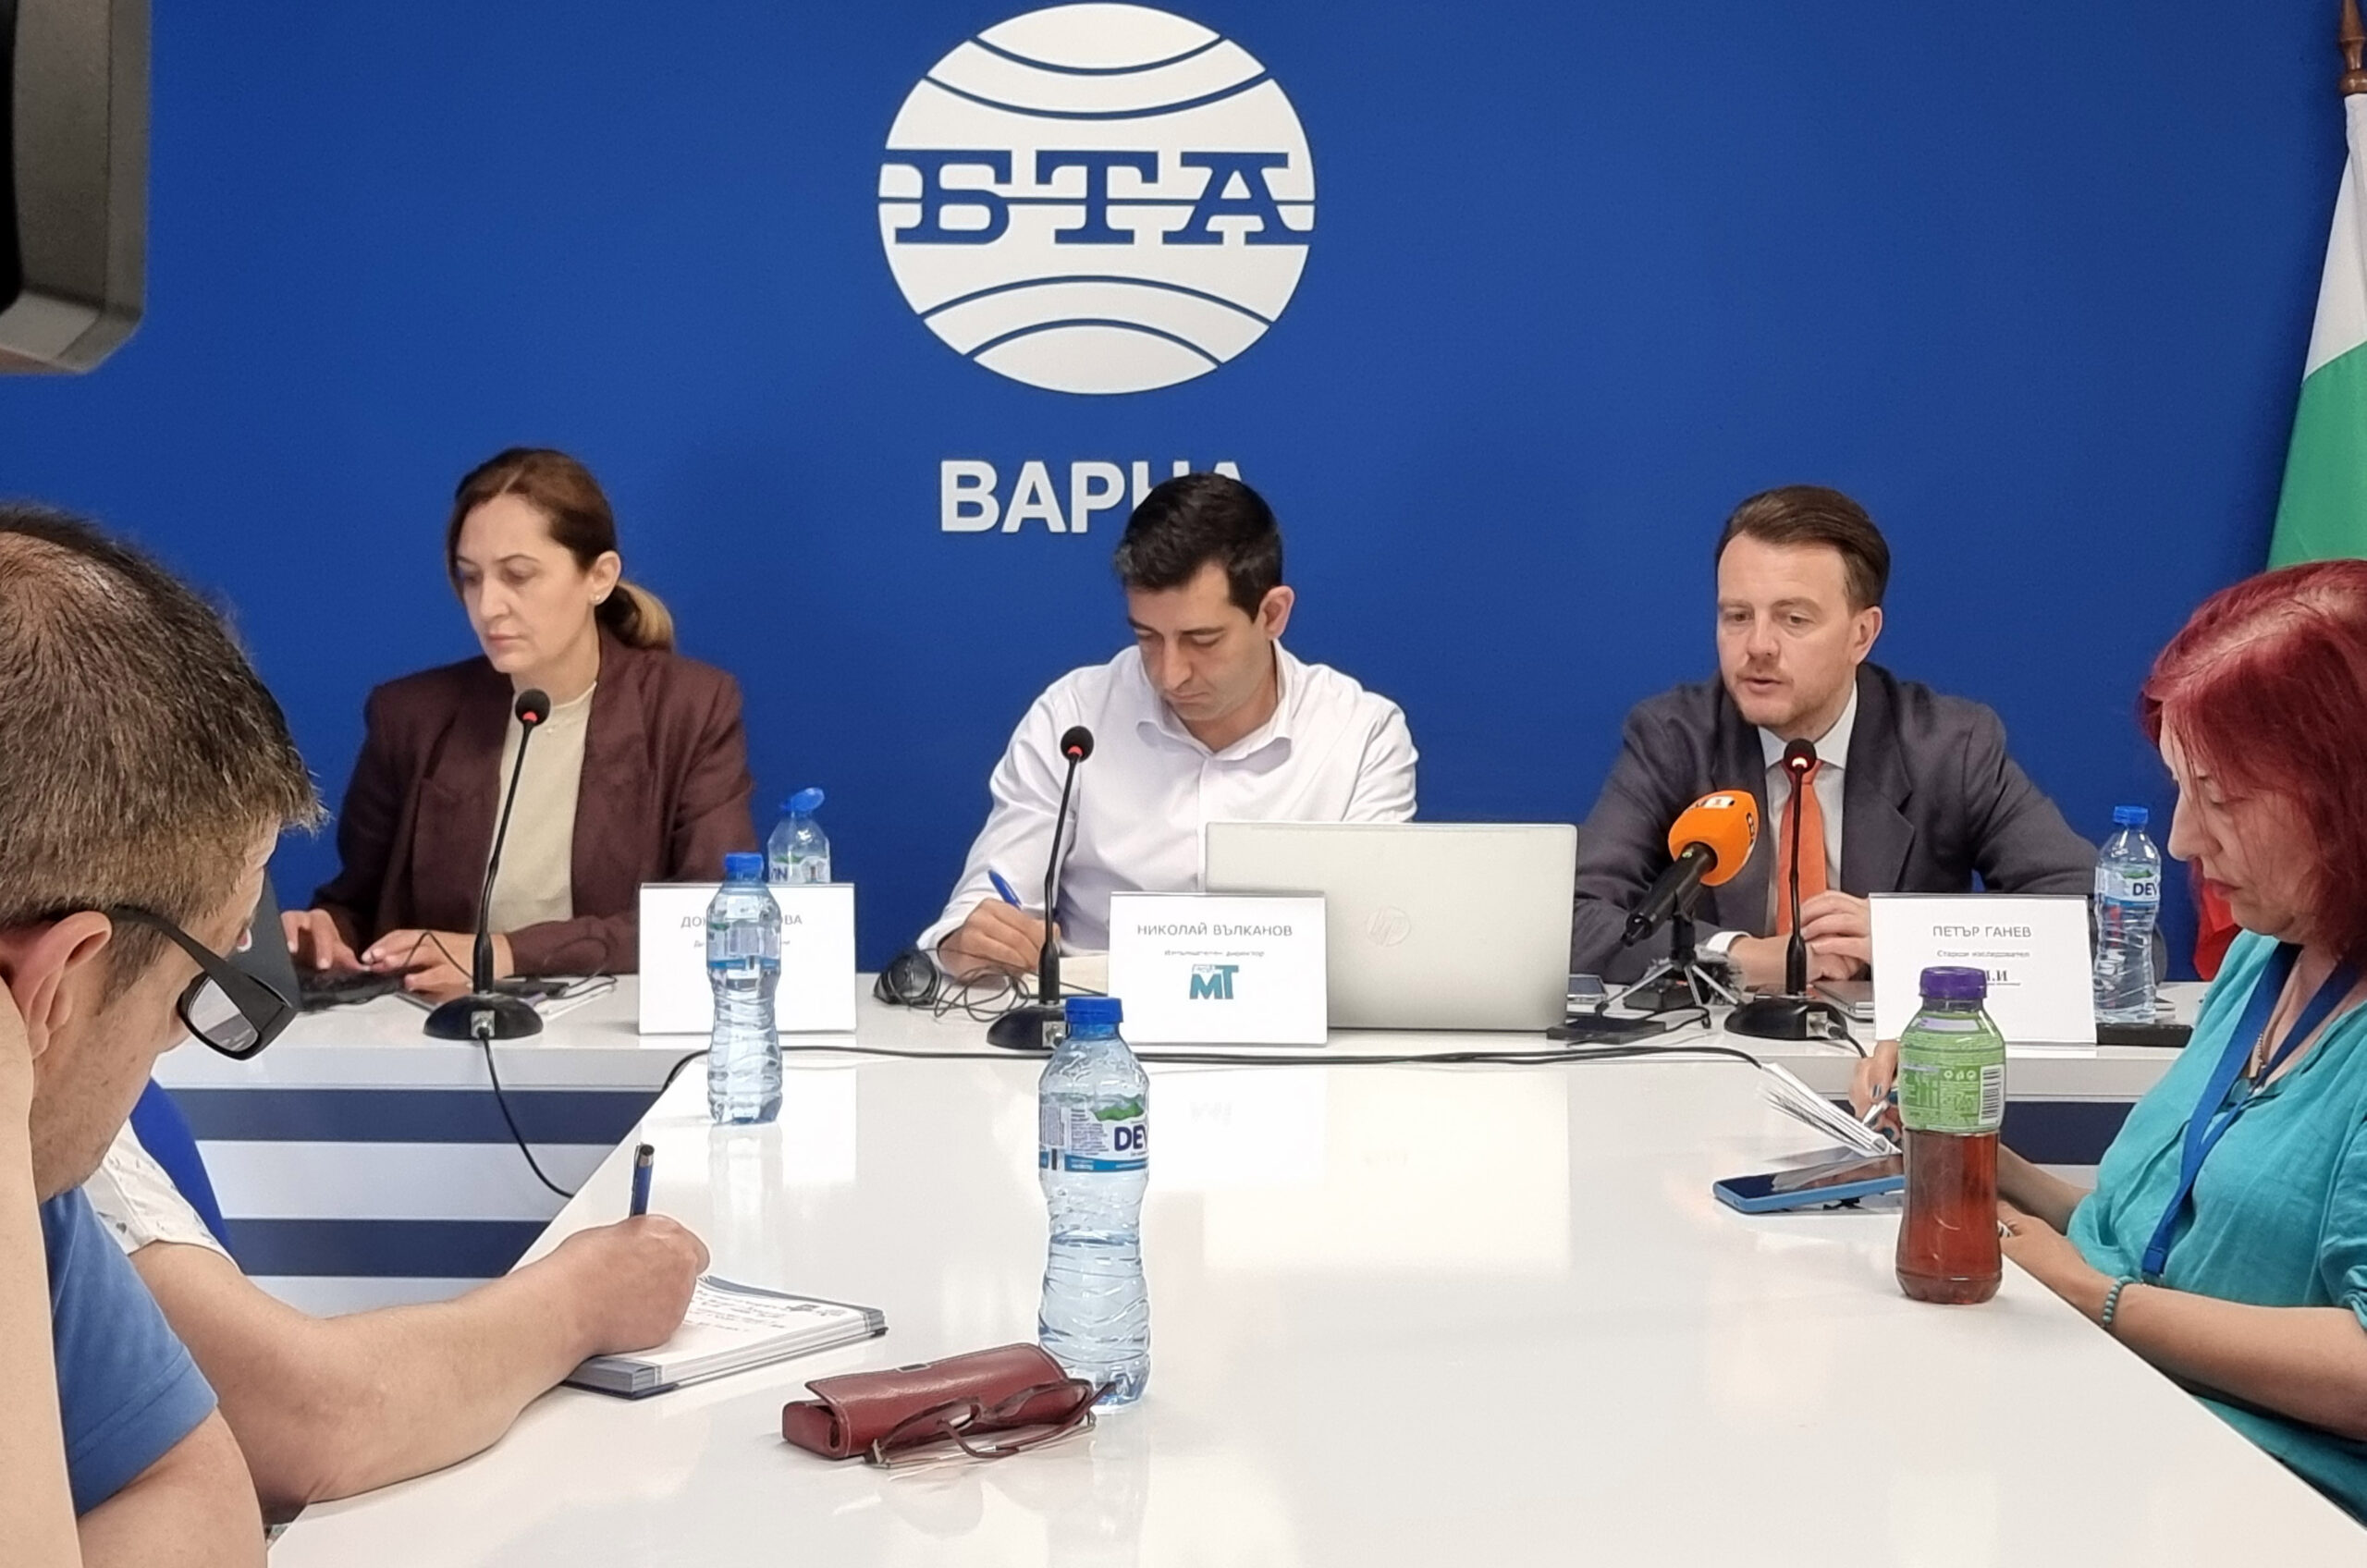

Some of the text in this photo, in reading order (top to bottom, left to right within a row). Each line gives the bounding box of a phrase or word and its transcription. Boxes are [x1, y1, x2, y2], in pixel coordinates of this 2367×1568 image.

[882, 149, 1312, 246] БТА
[941, 459, 1244, 533] ВАР
[1136, 922, 1294, 937] НИКОЛАЙ ВЪЛКАНОВ
[1932, 925, 2032, 937] ПЕТЪР ГАНЕВ
